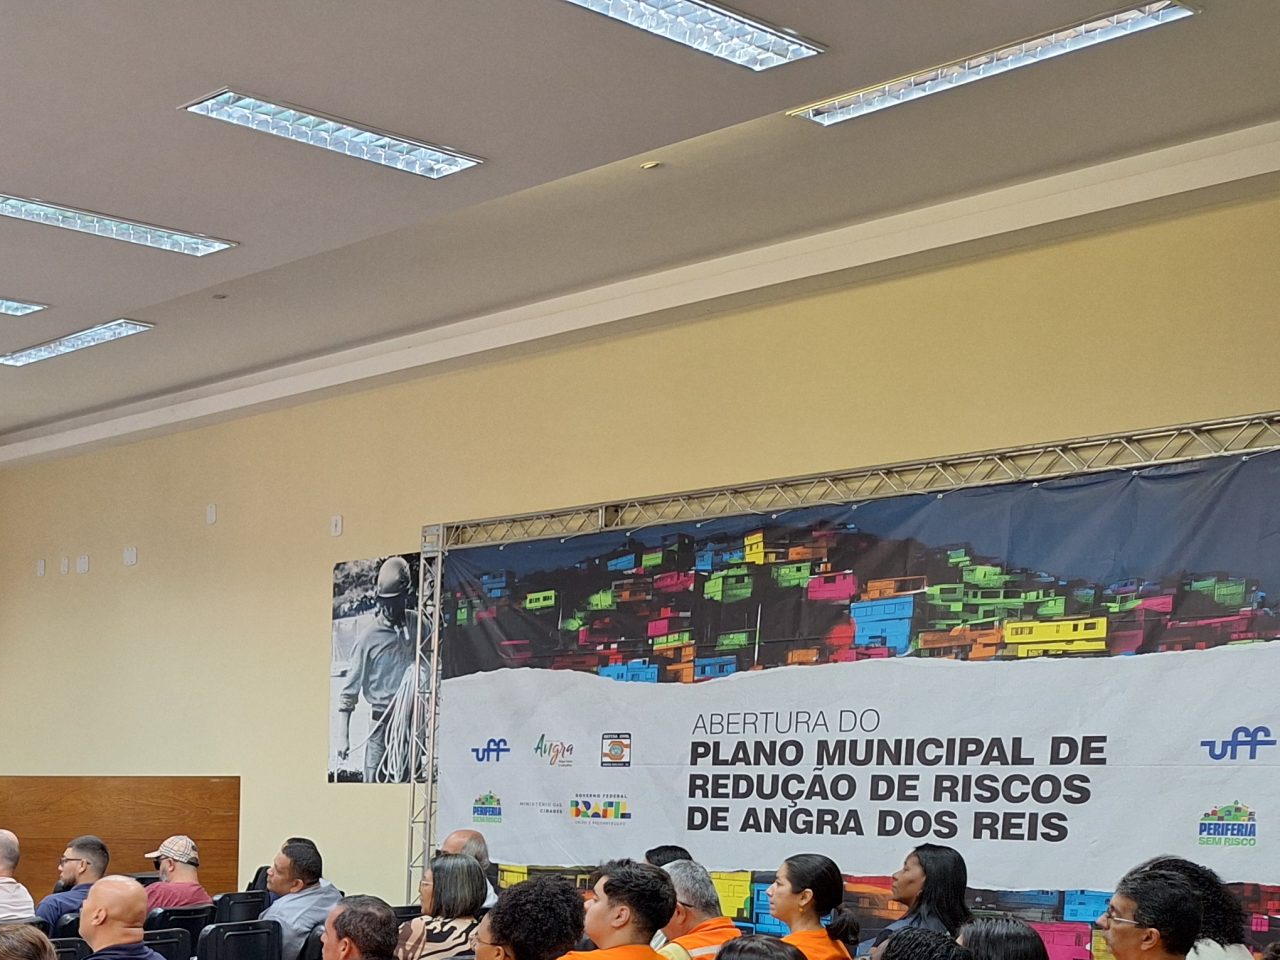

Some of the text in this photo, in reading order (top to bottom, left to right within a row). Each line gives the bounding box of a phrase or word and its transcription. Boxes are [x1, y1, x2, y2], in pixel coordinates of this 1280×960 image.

[692, 709, 881, 735] ABERTURA DO
[471, 733, 574, 766] uff Angra
[690, 735, 1108, 767] PLANO MUNICIPAL DE
[1200, 725, 1277, 760] uff
[688, 766, 1091, 808] REDUÇÃO DE RISCOS
[570, 800, 631, 819] BRASIL
[687, 806, 1069, 843] DE ANGRA DOS REIS
[1199, 823, 1256, 836] PERIFERIA
[1199, 837, 1257, 846] SEM RISCO
